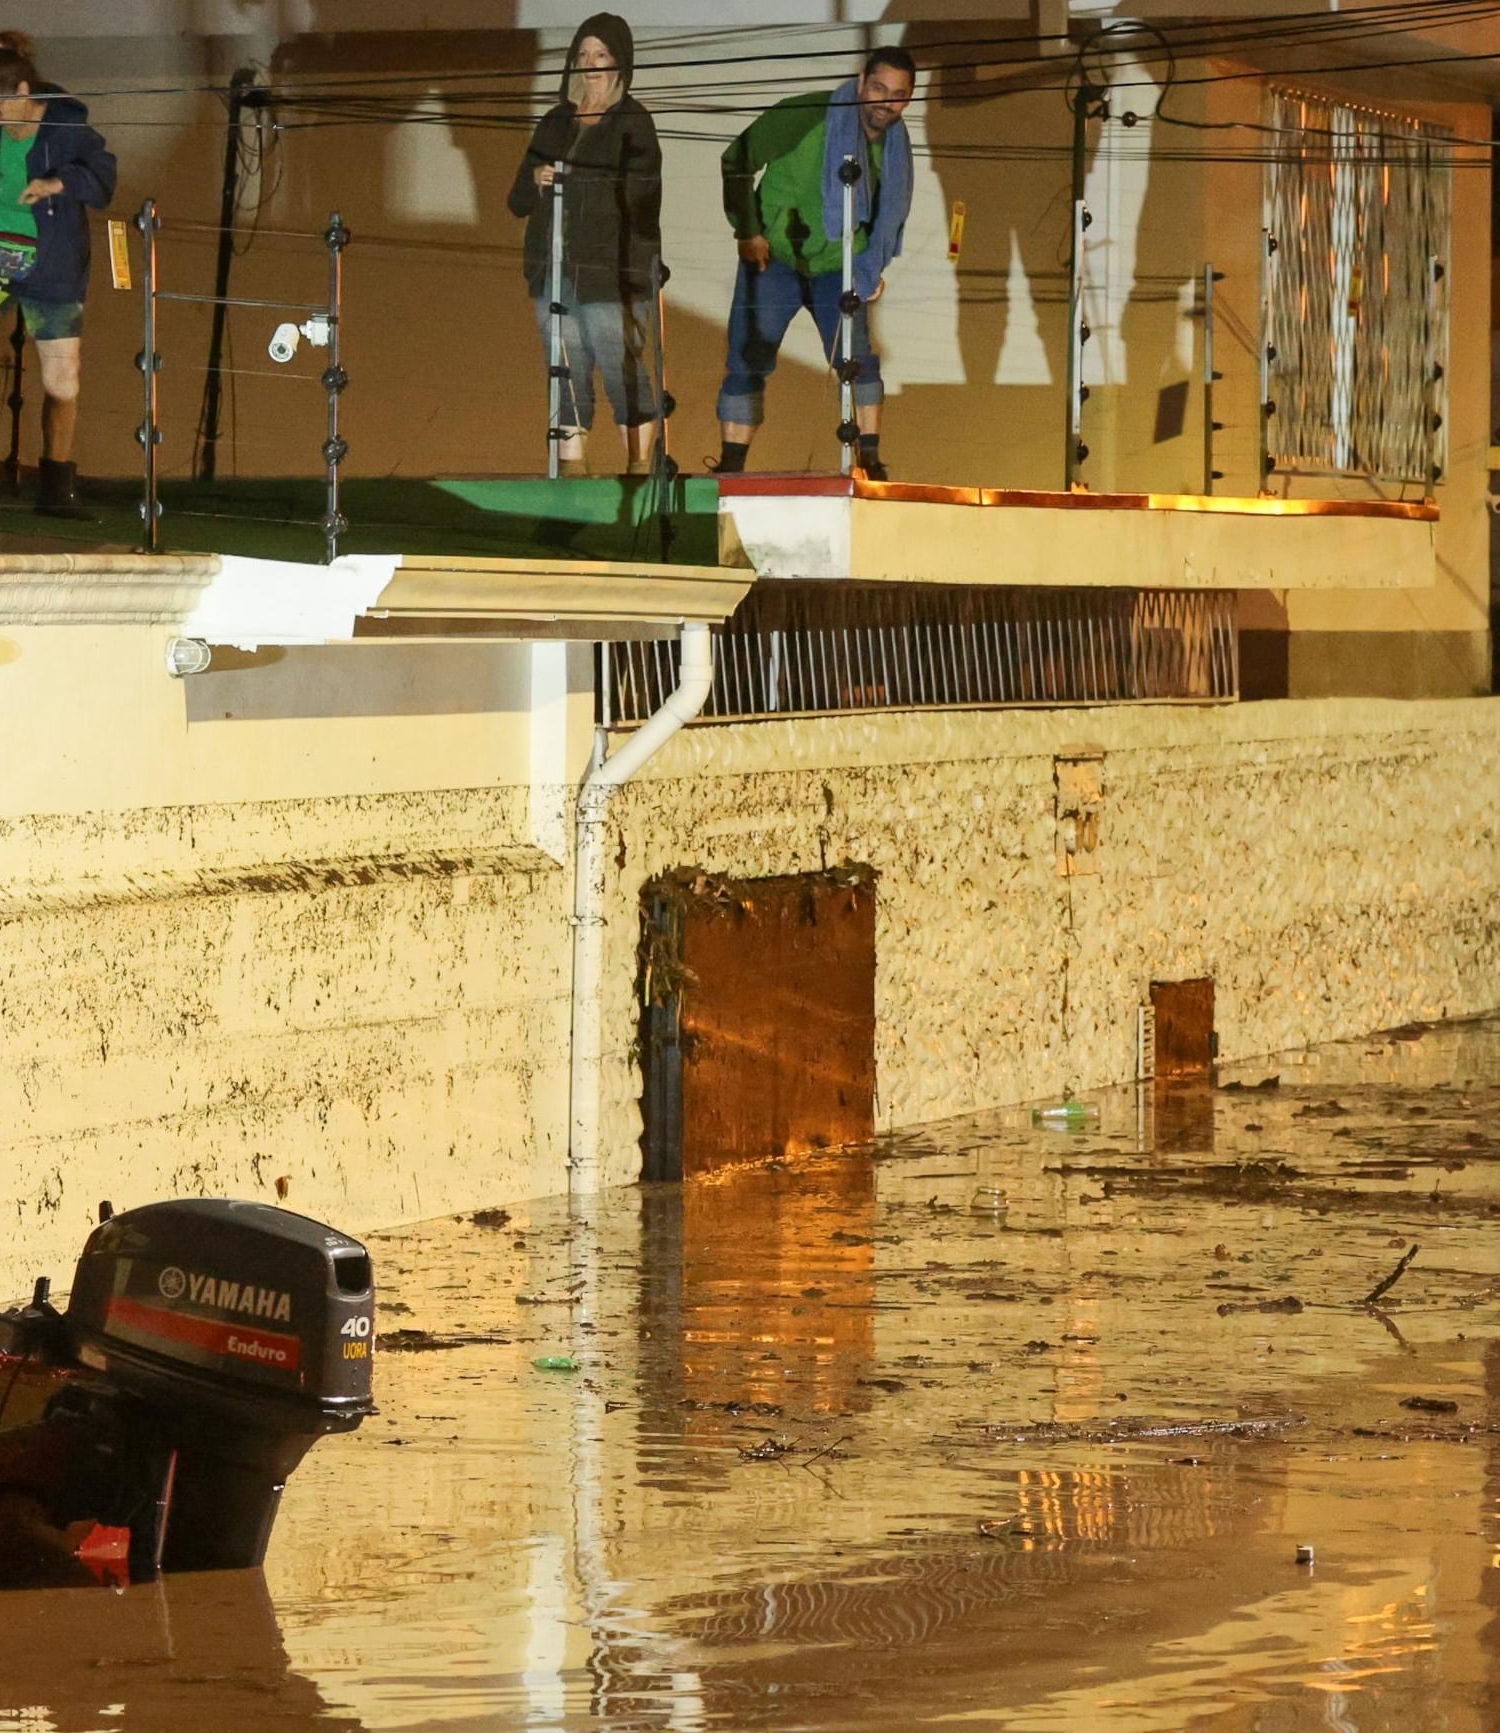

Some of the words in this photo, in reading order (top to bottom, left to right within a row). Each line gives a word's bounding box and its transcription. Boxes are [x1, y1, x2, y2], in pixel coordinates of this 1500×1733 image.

[189, 1272, 291, 1322] YAMAHA
[340, 1316, 370, 1337] 40
[227, 1335, 287, 1361] Enduro
